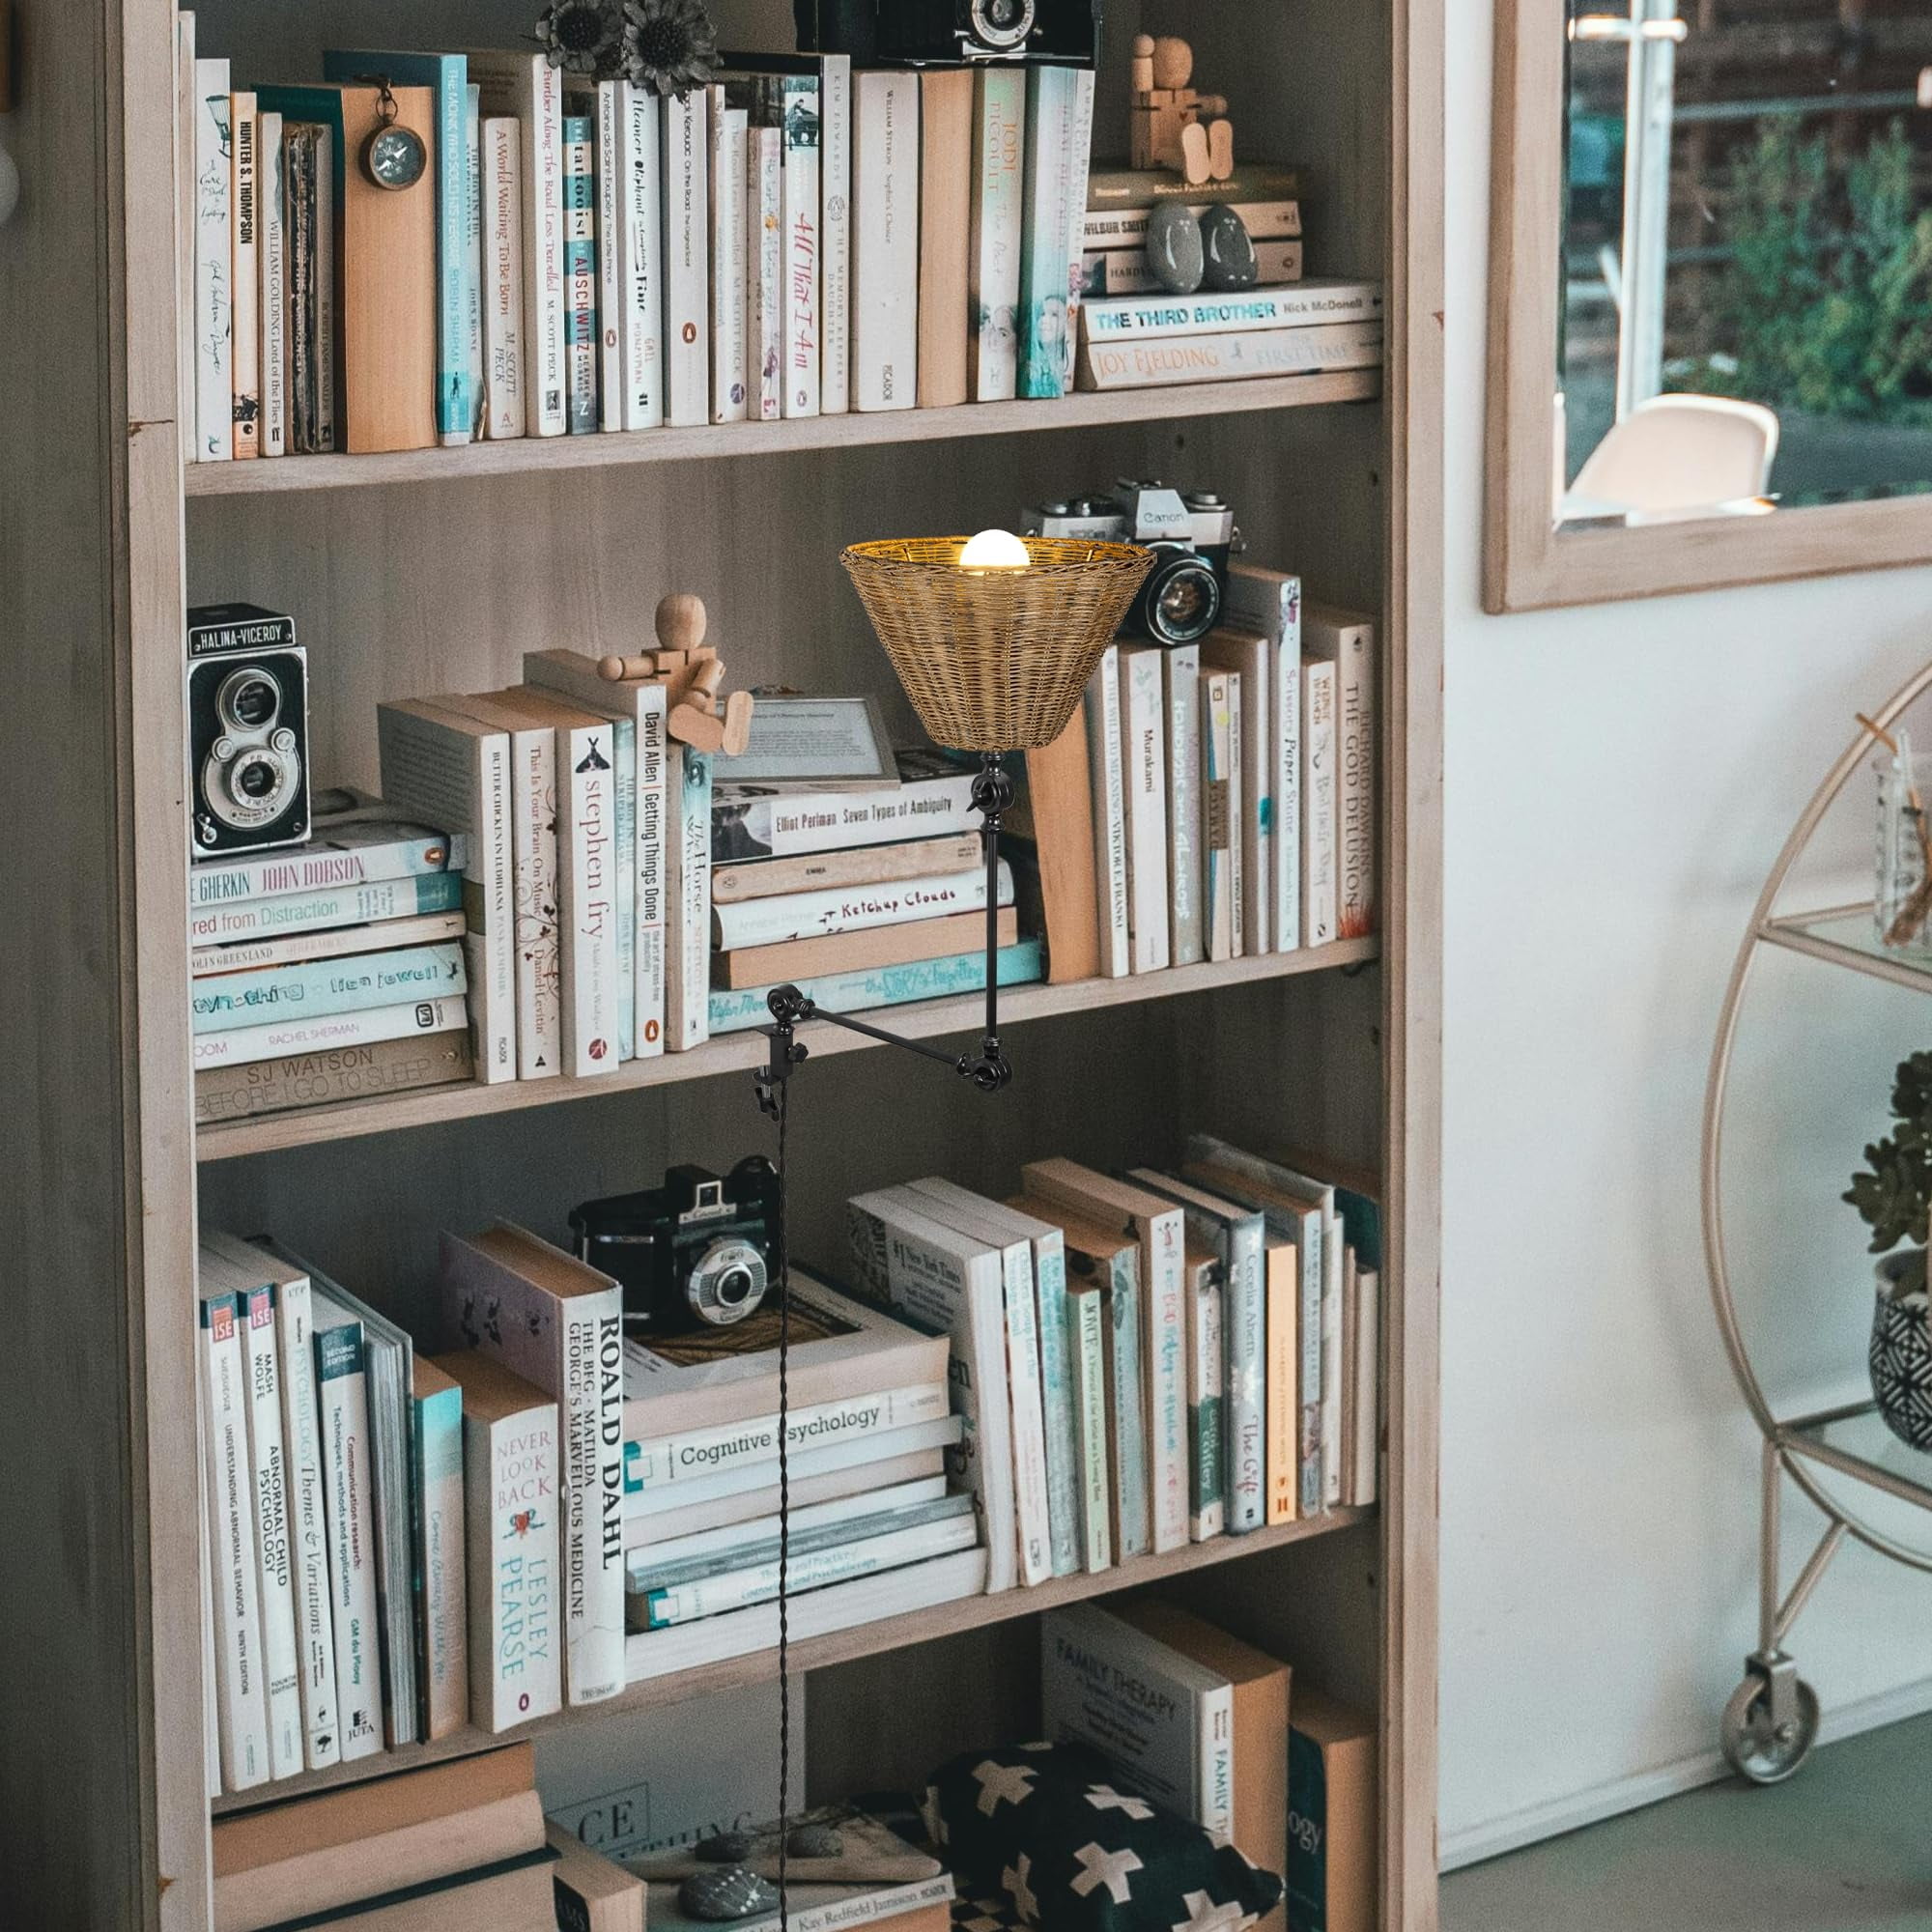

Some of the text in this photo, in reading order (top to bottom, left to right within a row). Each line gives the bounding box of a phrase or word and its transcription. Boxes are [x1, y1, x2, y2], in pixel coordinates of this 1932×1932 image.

[543, 71, 554, 112] Further
[543, 116, 556, 149] Along
[833, 112, 841, 181] EDWARDS
[240, 122, 252, 244] HUNTER S. THOMPSON
[544, 180, 556, 210] Road
[545, 153, 555, 176] The
[496, 130, 512, 315] A World Waiting To Be Born
[545, 213, 555, 238] Less
[632, 100, 648, 313] Eleanor Oliphant Fine
[545, 240, 556, 293] Travelled
[574, 146, 589, 352] tattooist AUSCHWITZ
[270, 220, 281, 425] WILLIAM GOLDING Lord of the Flies
[547, 299, 555, 311] M.
[793, 213, 813, 369] All That I Am
[1096, 298, 1363, 329] THE THIRD BROTHER Nick McDonell
[495, 347, 506, 383] PECK
[505, 331, 517, 396] M. SCOTT
[548, 352, 556, 382] PECK
[1144, 512, 1184, 523] Canon
[199, 624, 282, 650] HALINA-VICEROY
[1144, 729, 1155, 793] Murakami
[1283, 669, 1297, 834] Scissors Paper Stone
[640, 712, 661, 921] David Allen Getting Things Done
[776, 797, 952, 832] Elliot Perlman Seven Types of Ambiguity
[1346, 682, 1359, 908] THE GOD DELUSION
[1359, 710, 1371, 876] RICHARD DAWKINS
[492, 752, 504, 911] BUTTER CHICKEN IN LUDHIANA
[579, 780, 610, 940] stephen fry
[199, 856, 365, 902] GHERKIN JOHN DOBSON
[530, 746, 547, 1035] This Is Your Brain On Music Daniel Levitin
[841, 890, 955, 918] Ketchup Clouds
[222, 916, 256, 932] from
[261, 900, 338, 925] Distraction
[216, 947, 273, 966] GREENLAND
[269, 1023, 359, 1046] RACHEL SHERMAN
[283, 1049, 374, 1075] WATSON
[214, 1321, 234, 1342] ISE
[253, 1308, 270, 1327] ISE
[255, 1353, 265, 1400] WOLFE
[265, 1354, 273, 1393] MASH
[582, 1320, 595, 1487] THE BFG MATILDA
[1236, 1254, 1260, 1496] Cecelia Ahern The Gift
[295, 1348, 314, 1463] PSYCHOLOGY
[497, 1430, 552, 1460] NEVER
[501, 1454, 547, 1484] LOOK
[569, 1322, 583, 1620] GEORGE'S MARVELLOUS MEDICINE
[600, 1314, 621, 1570] ROALD DAHL
[680, 1433, 772, 1466] Cognitive
[260, 1469, 276, 1573] PSYCHOLOGY
[270, 1446, 287, 1586] ABNORMAL CHILD
[301, 1463, 315, 1526] Themes
[332, 1406, 352, 1607] Techniques, methods and applications
[347, 1436, 362, 1570] Communication research:
[497, 1476, 553, 1510] BACK
[224, 1424, 249, 1695] UNDERSTANDING ABNORMAL BEHAVIOR NINTH EDITION
[303, 1530, 318, 1548] &
[306, 1552, 322, 1634] Variations
[499, 1555, 524, 1680] PEARSE
[528, 1558, 548, 1660] LESLEY
[351, 1619, 361, 1685] GM du Plooy
[1214, 1748, 1232, 1811] FAMILY
[799, 1884, 947, 1931] Kay Redfield Jamison PICADOR
